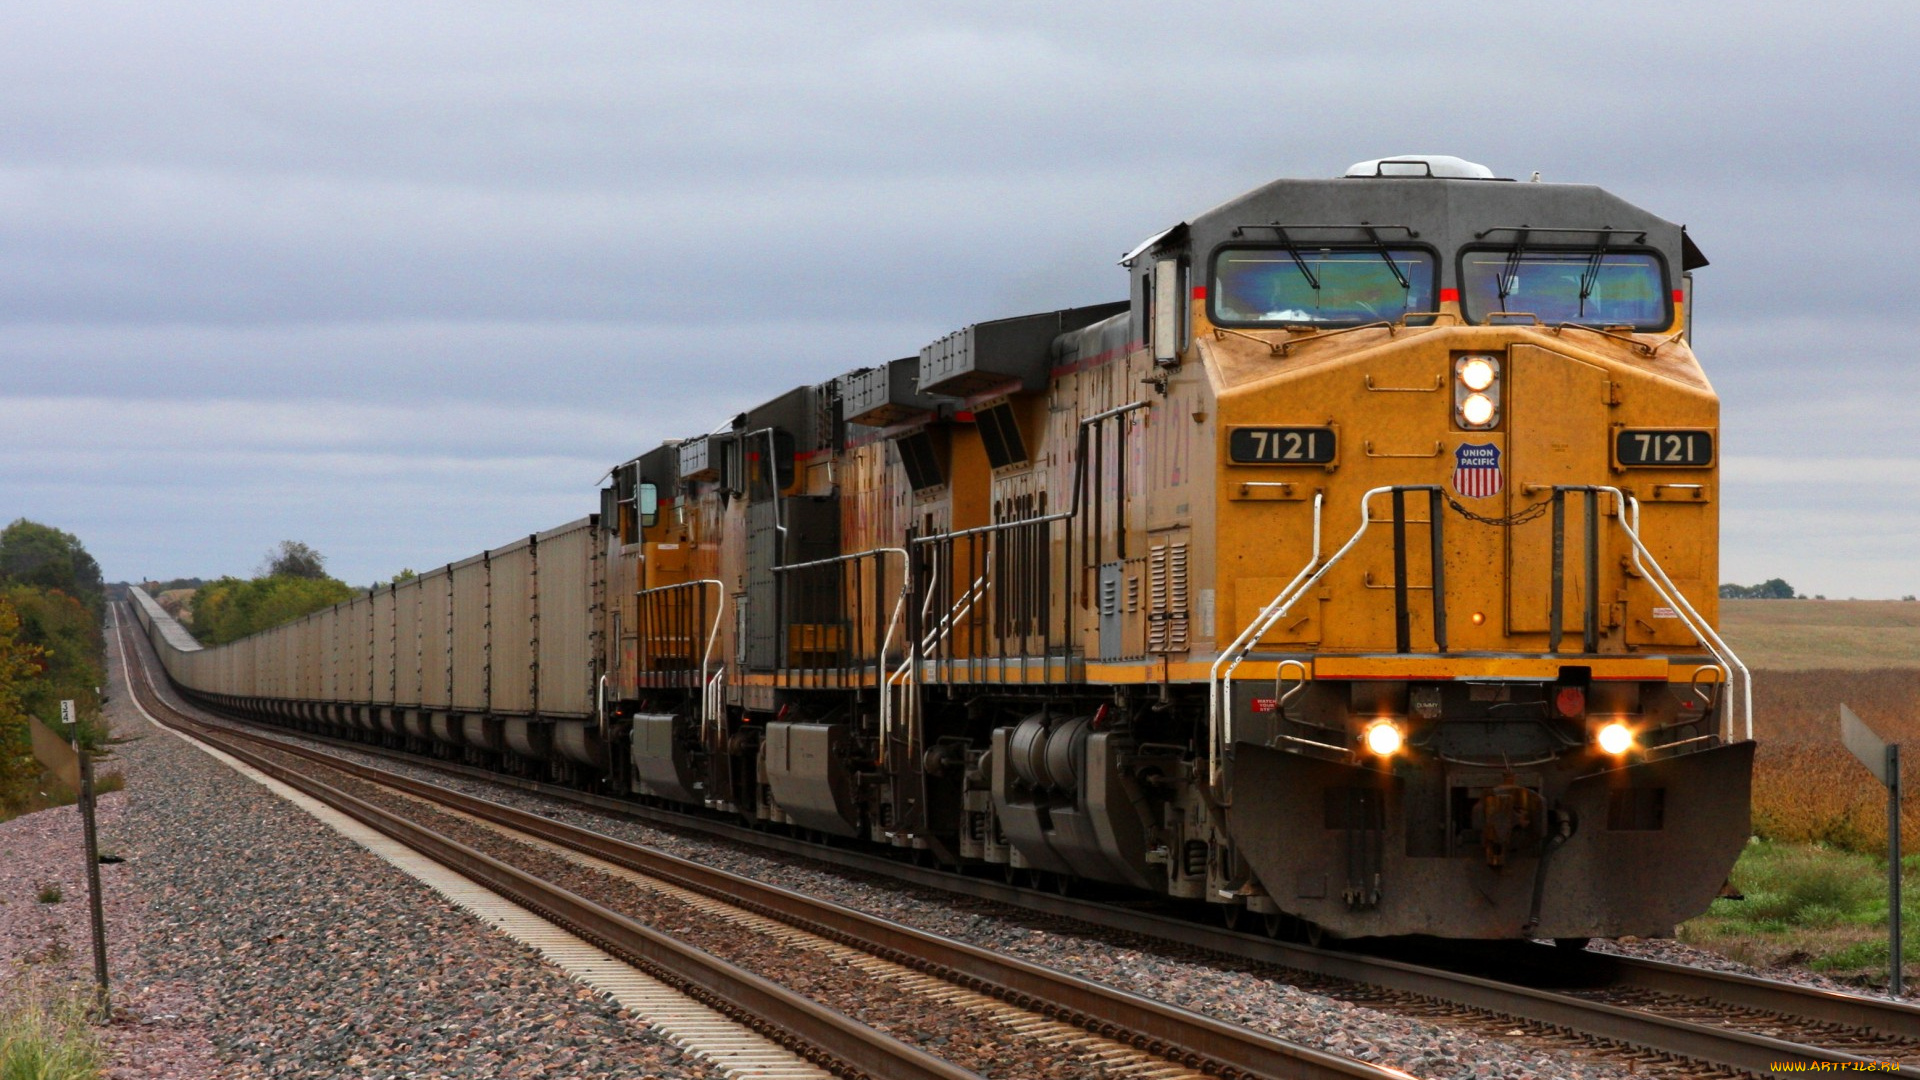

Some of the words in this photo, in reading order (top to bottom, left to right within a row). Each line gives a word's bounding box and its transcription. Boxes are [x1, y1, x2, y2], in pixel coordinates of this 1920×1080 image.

[1250, 432, 1315, 459] 7121
[1462, 449, 1494, 457] UNION
[1634, 434, 1694, 461] 7121
[1460, 458, 1495, 466] PACIFIC
